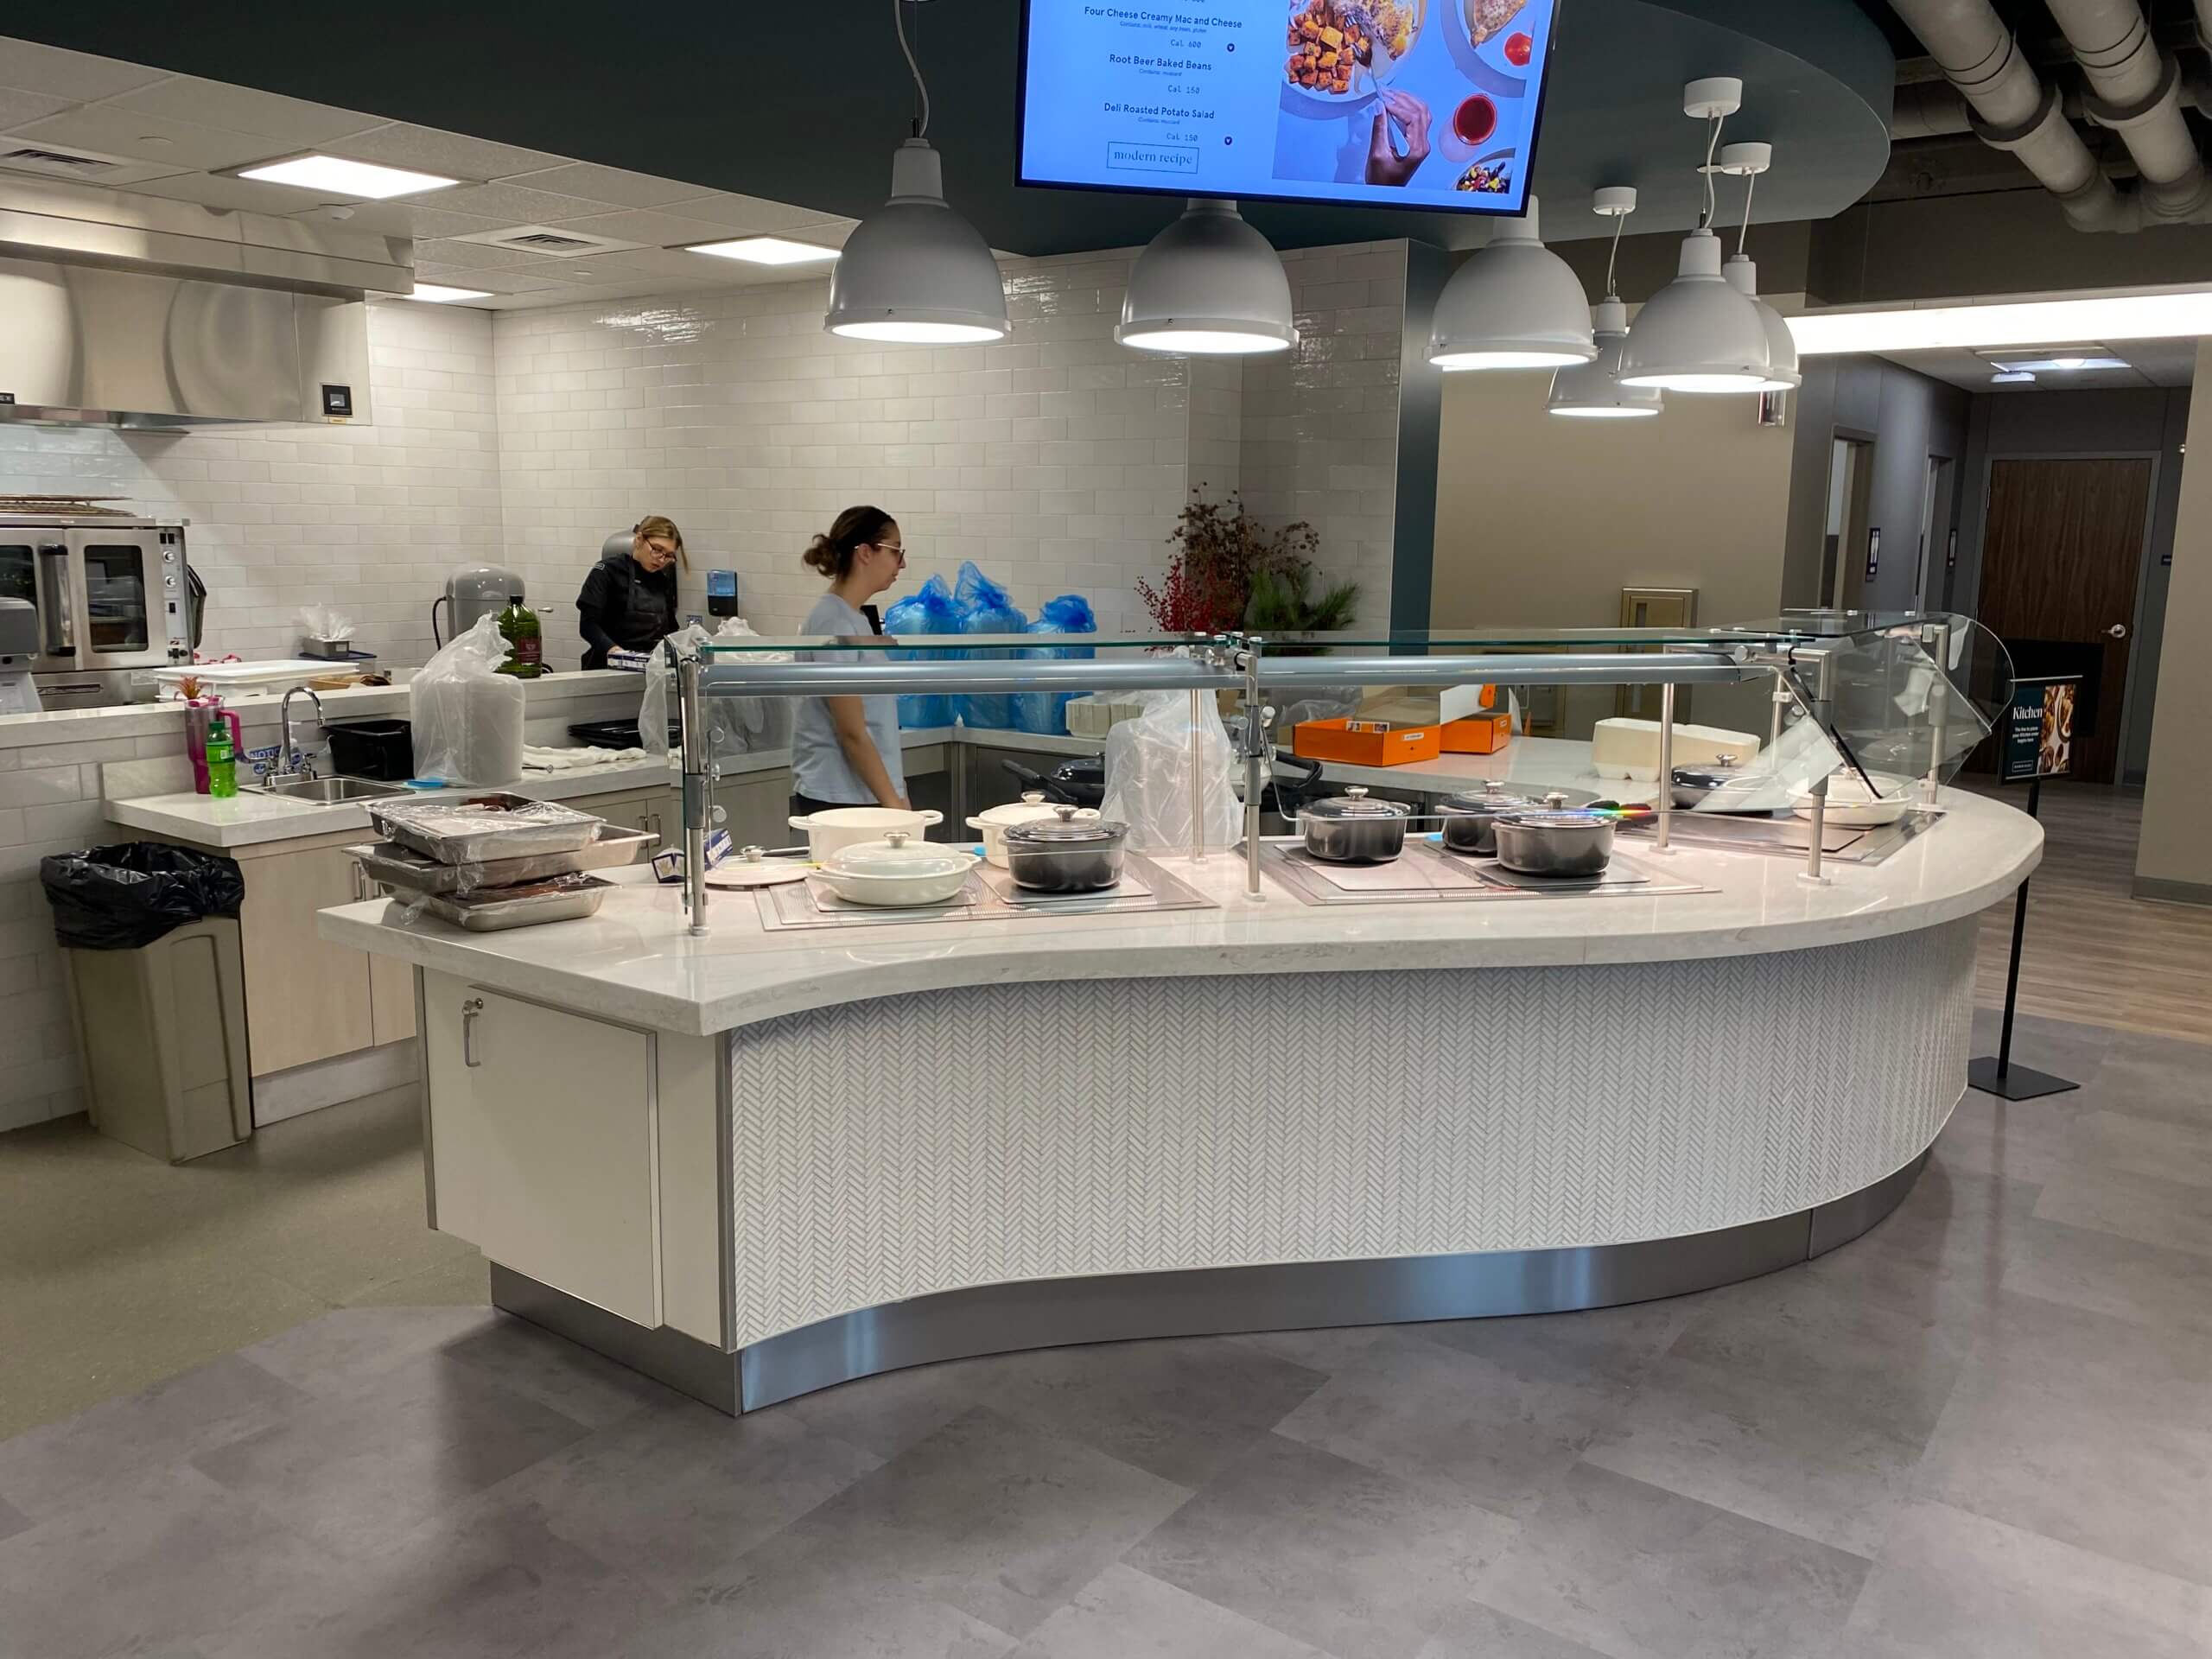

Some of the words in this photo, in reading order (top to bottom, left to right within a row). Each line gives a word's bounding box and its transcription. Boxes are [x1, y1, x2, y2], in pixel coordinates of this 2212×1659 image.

[1084, 7, 1105, 16] Four
[1107, 9, 1138, 19] Cheese
[1141, 12, 1173, 23] Creamy
[1175, 15, 1192, 24] Mac
[1194, 17, 1209, 26] and
[1211, 18, 1242, 28] Cheese
[1109, 54, 1131, 64] Root
[1134, 56, 1154, 66] Beer
[1157, 58, 1184, 68] Baked
[1186, 60, 1211, 70] Beans
[1104, 103, 1122, 111] Deli
[1123, 105, 1159, 115] Roasted
[1161, 107, 1190, 118] Potato
[1192, 110, 1214, 118] Salad
[1114, 149, 1156, 162] modern
[1160, 154, 1193, 166] recipe
[2012, 705, 2043, 720] Kitchen
